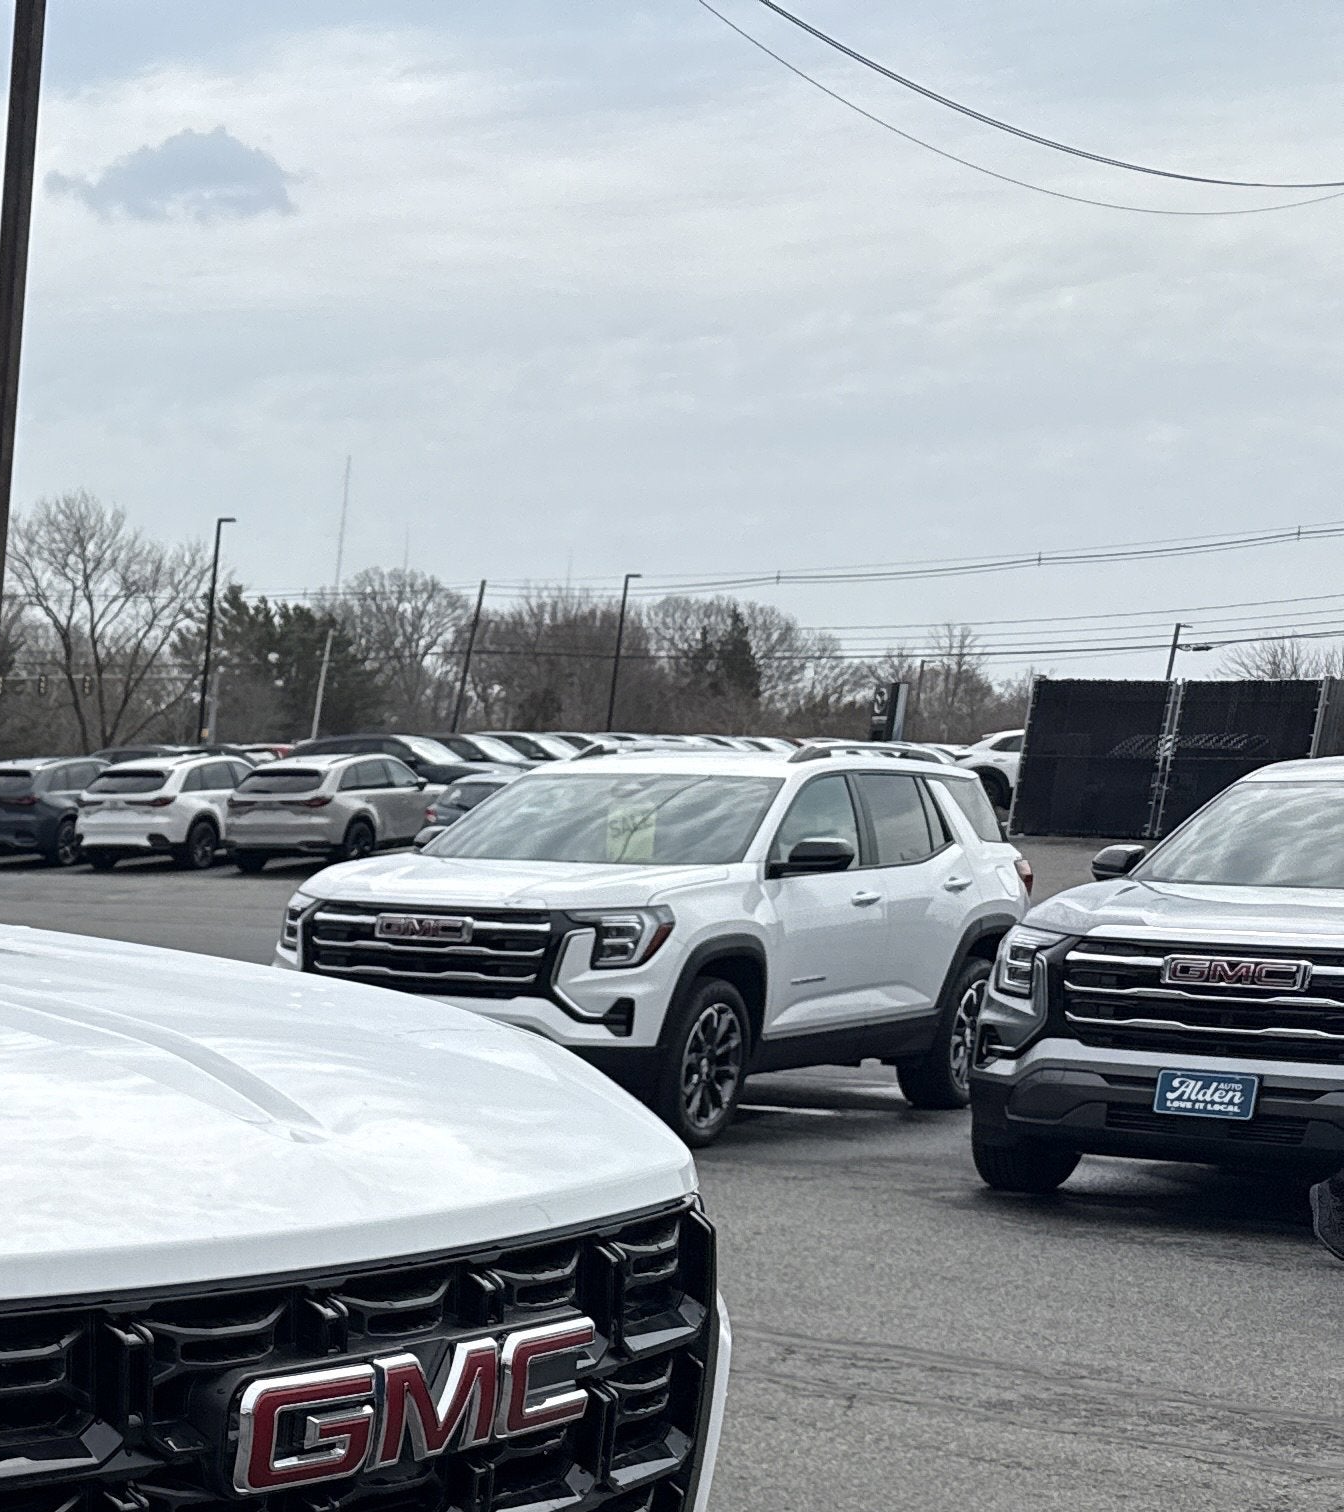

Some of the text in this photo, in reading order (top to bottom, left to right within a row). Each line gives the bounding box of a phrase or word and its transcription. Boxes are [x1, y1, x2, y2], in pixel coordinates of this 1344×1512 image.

[383, 918, 463, 938] GMC
[1171, 960, 1297, 986] GMC
[1166, 1077, 1244, 1104] Alden
[1217, 1083, 1243, 1091] AUTO
[1166, 1100, 1240, 1113] LOVE IT LOCAL
[233, 1316, 596, 1493] GMC
